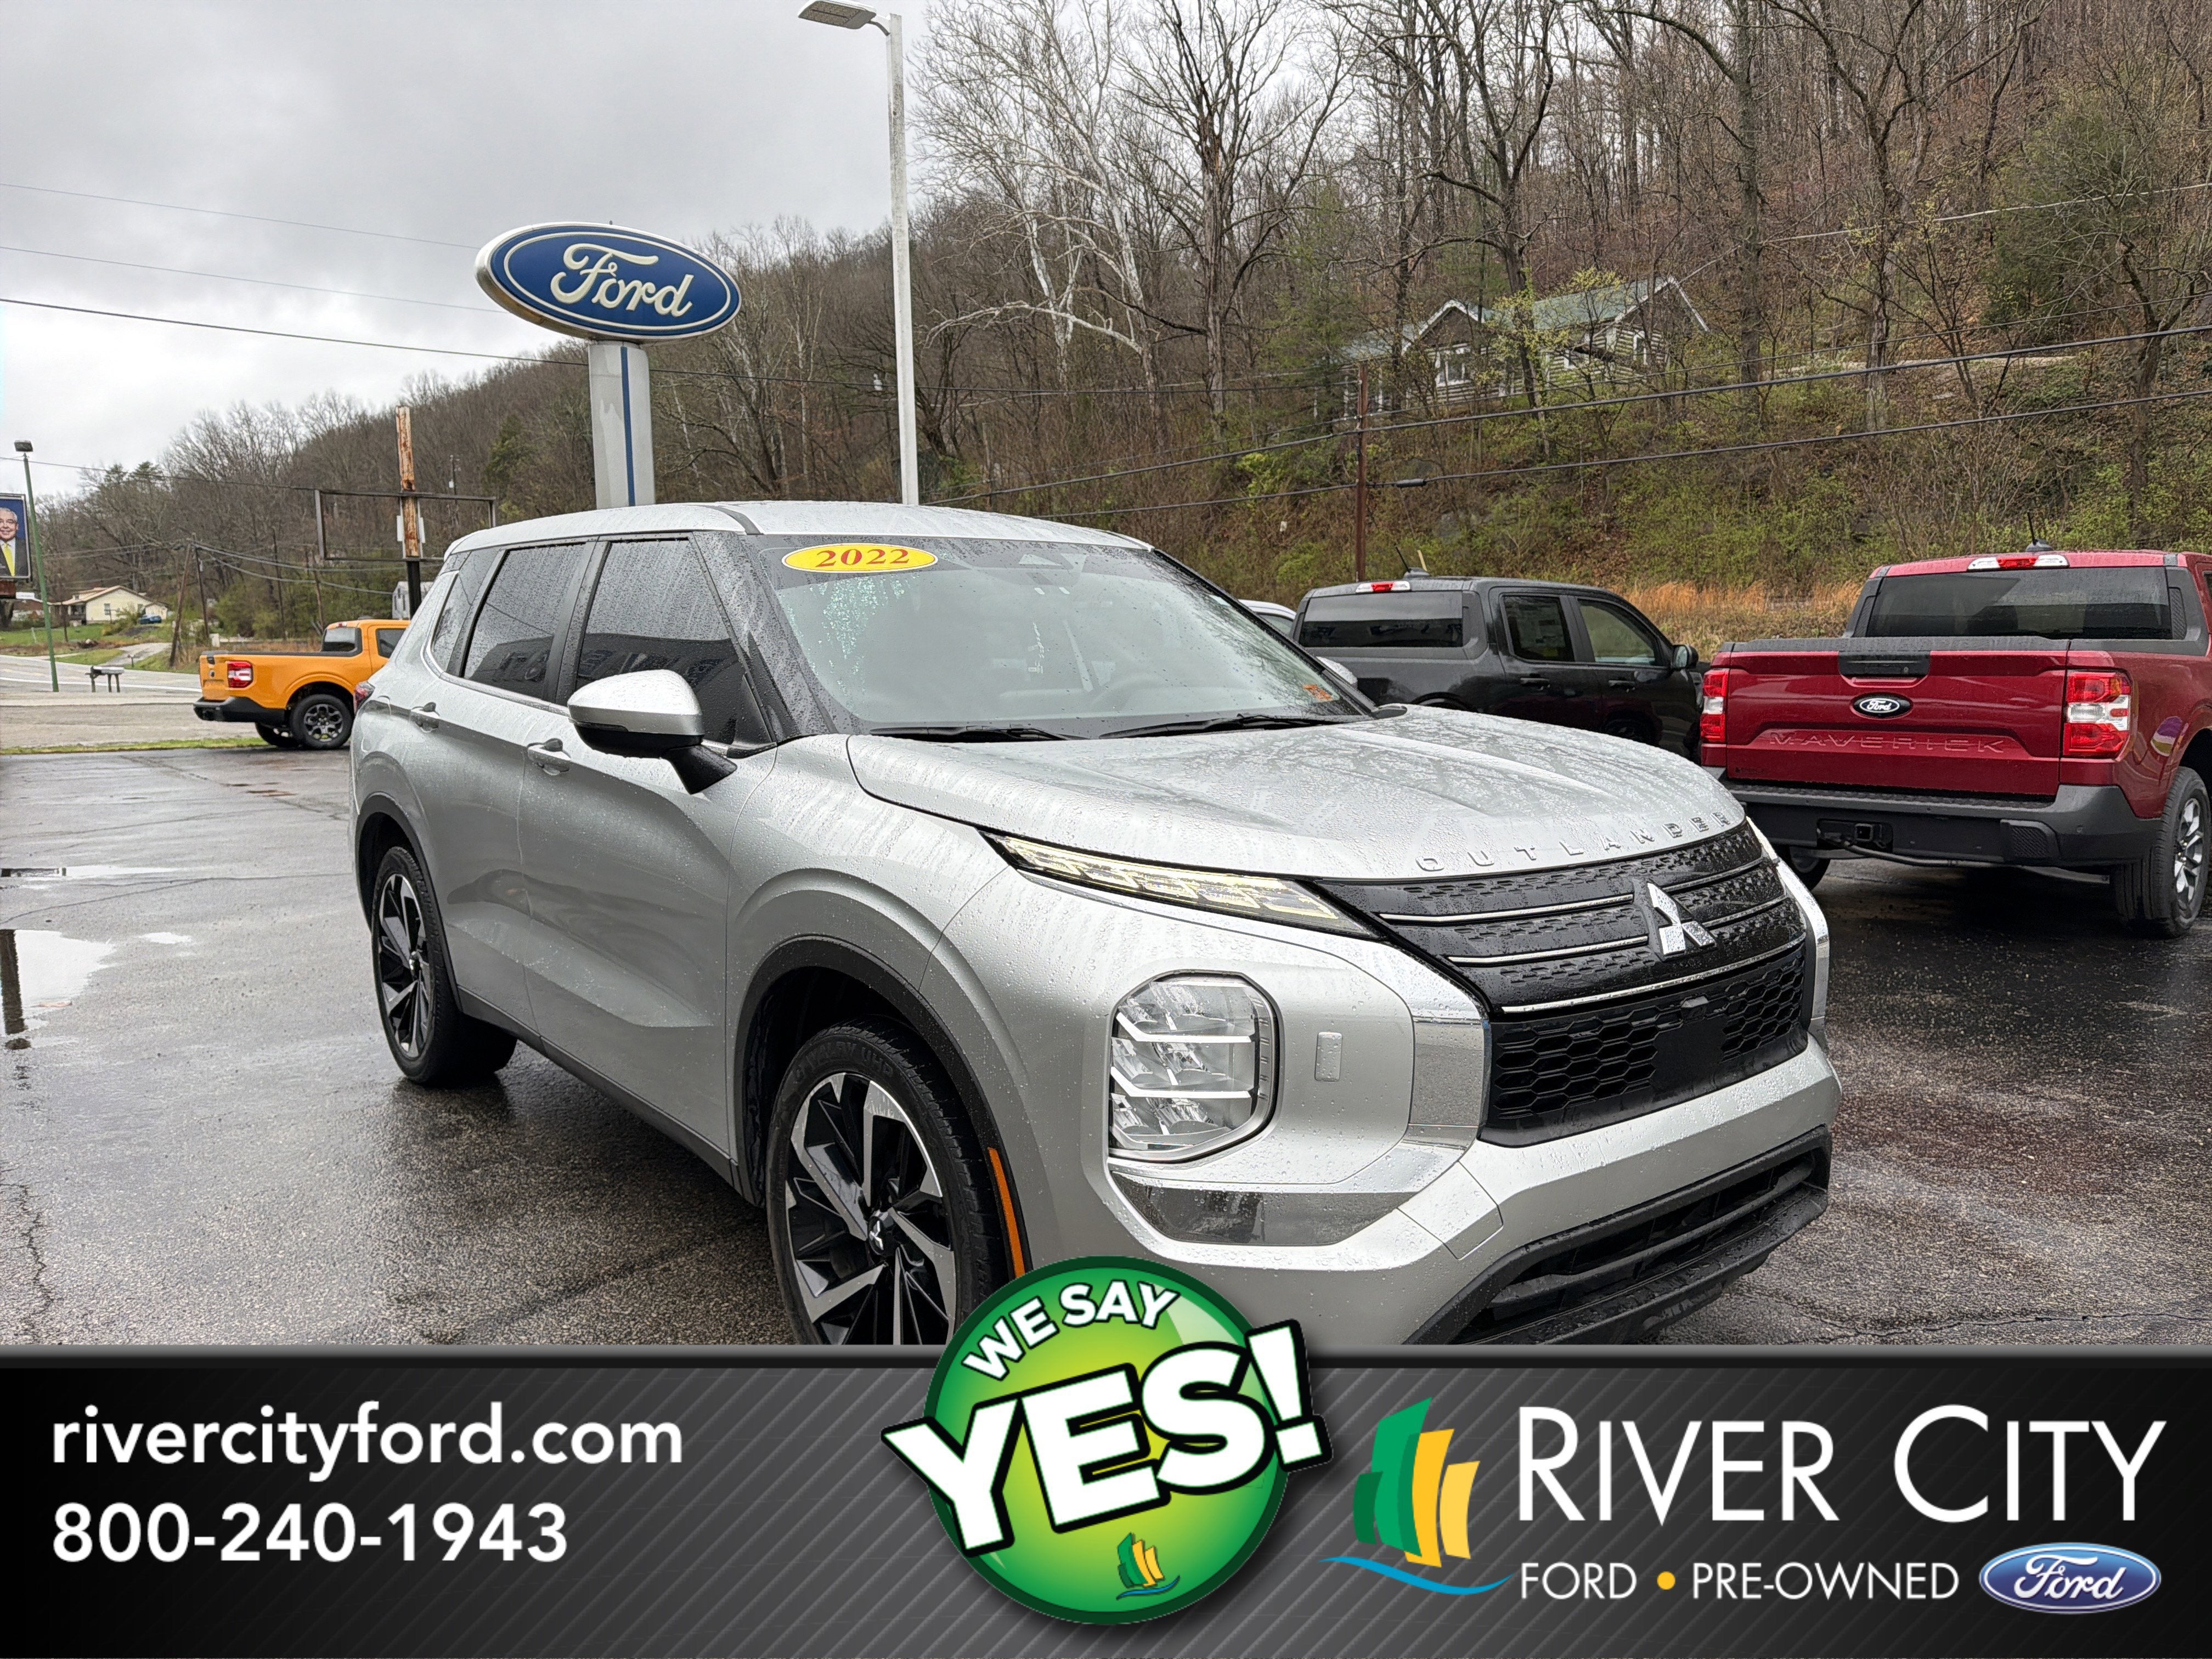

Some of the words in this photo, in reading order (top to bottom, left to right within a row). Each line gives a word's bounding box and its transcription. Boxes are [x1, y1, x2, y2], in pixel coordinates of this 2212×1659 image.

[550, 243, 694, 318] Ford
[815, 549, 910, 567] 2022
[1866, 699, 1892, 710] Ford
[1769, 732, 2004, 754] MAVERICK
[1415, 812, 1730, 871] OUTLANDER
